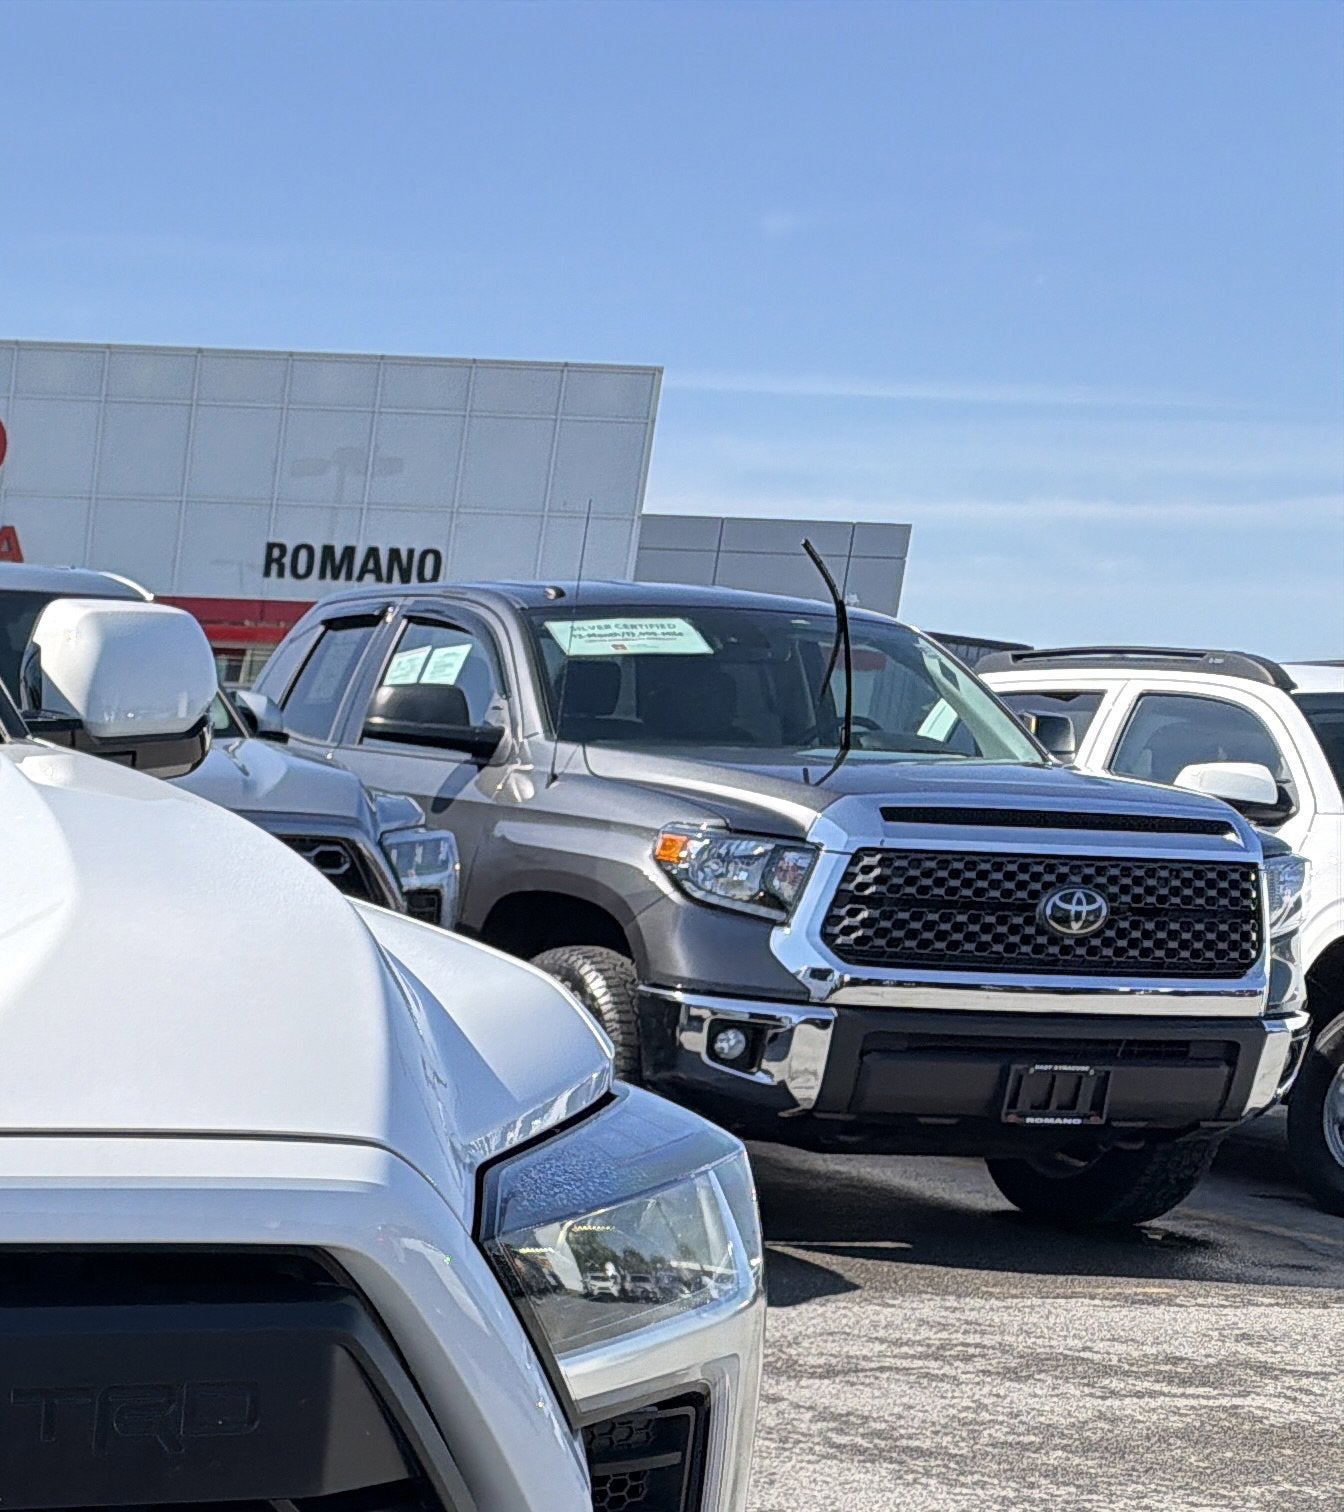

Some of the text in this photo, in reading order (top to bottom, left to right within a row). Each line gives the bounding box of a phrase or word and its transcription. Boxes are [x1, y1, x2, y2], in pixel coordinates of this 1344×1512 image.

[263, 541, 443, 585] ROMANO
[614, 622, 677, 630] CERTIFIED
[9, 1379, 261, 1457] TRD
